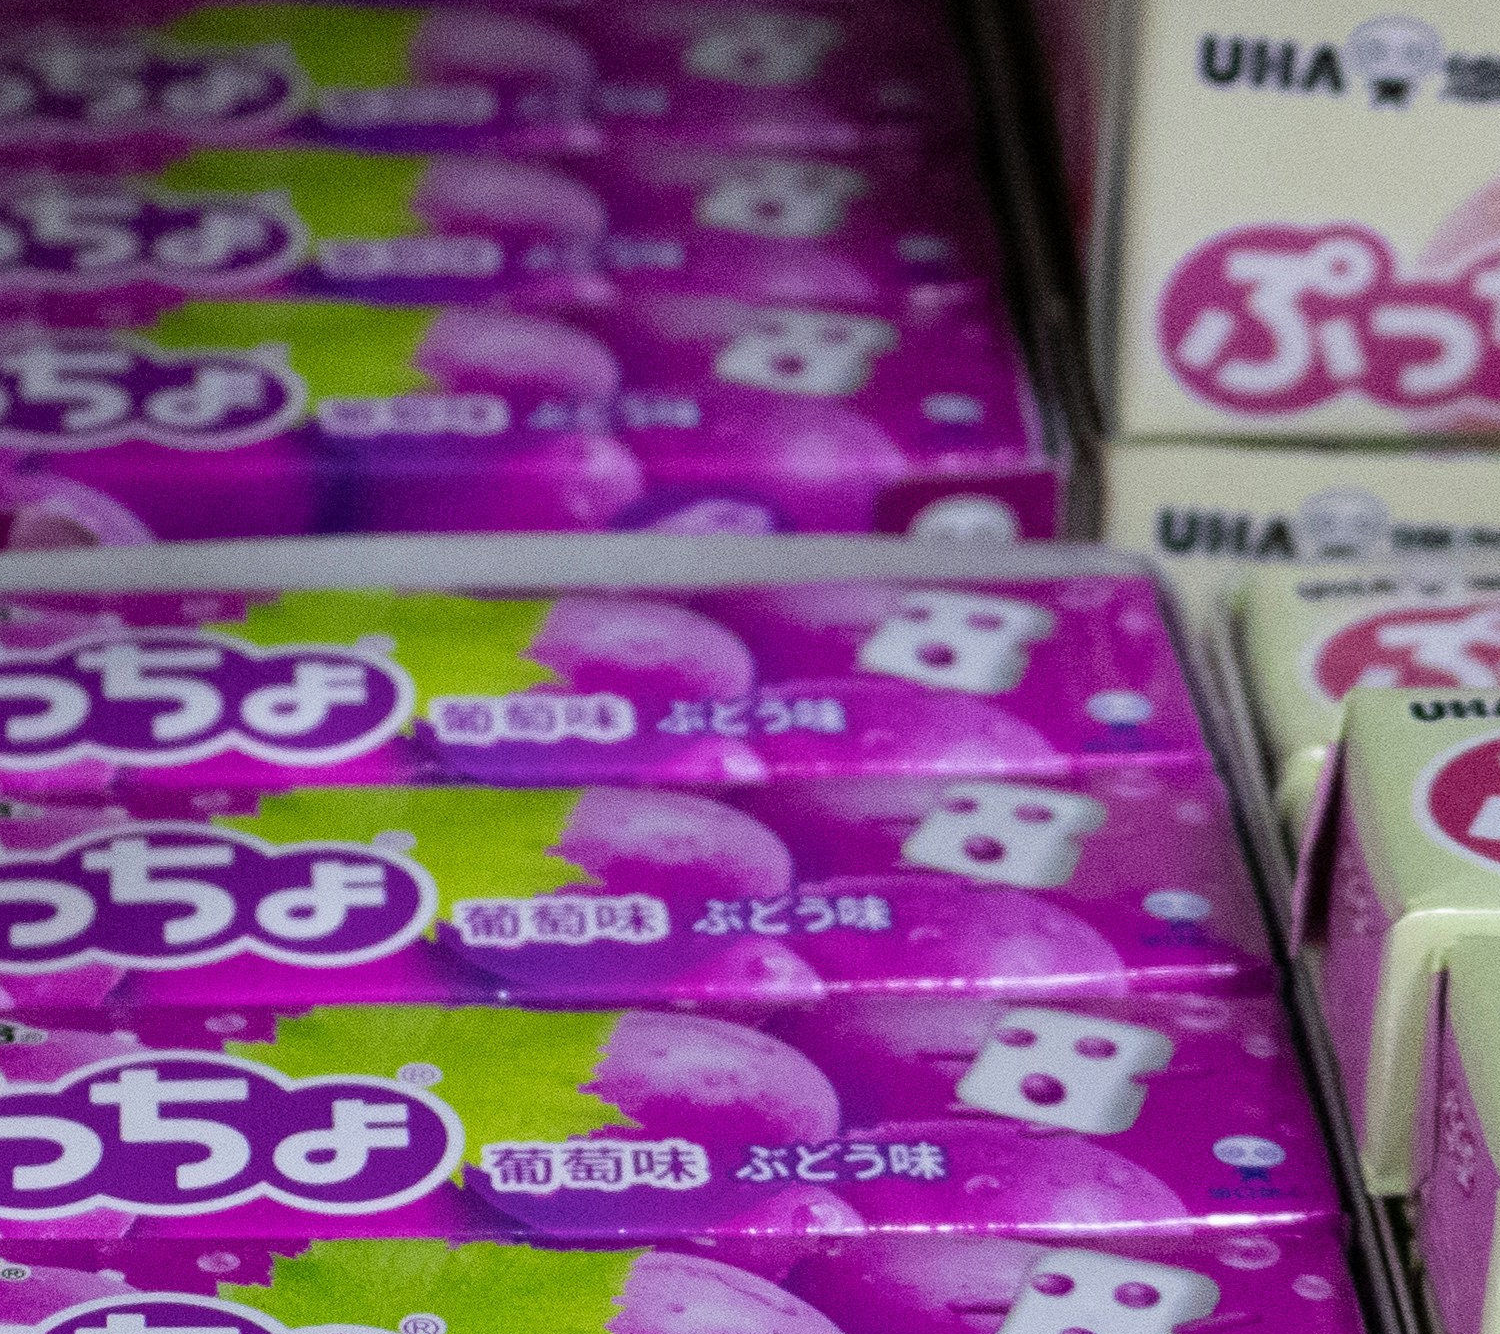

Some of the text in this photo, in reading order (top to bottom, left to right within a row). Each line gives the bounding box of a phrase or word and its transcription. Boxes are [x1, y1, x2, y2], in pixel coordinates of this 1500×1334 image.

[1201, 36, 1344, 93] UHA
[462, 895, 892, 942] 葡萄味 ぶどう味
[492, 1144, 947, 1186] 葡萄味 ぶどう味
